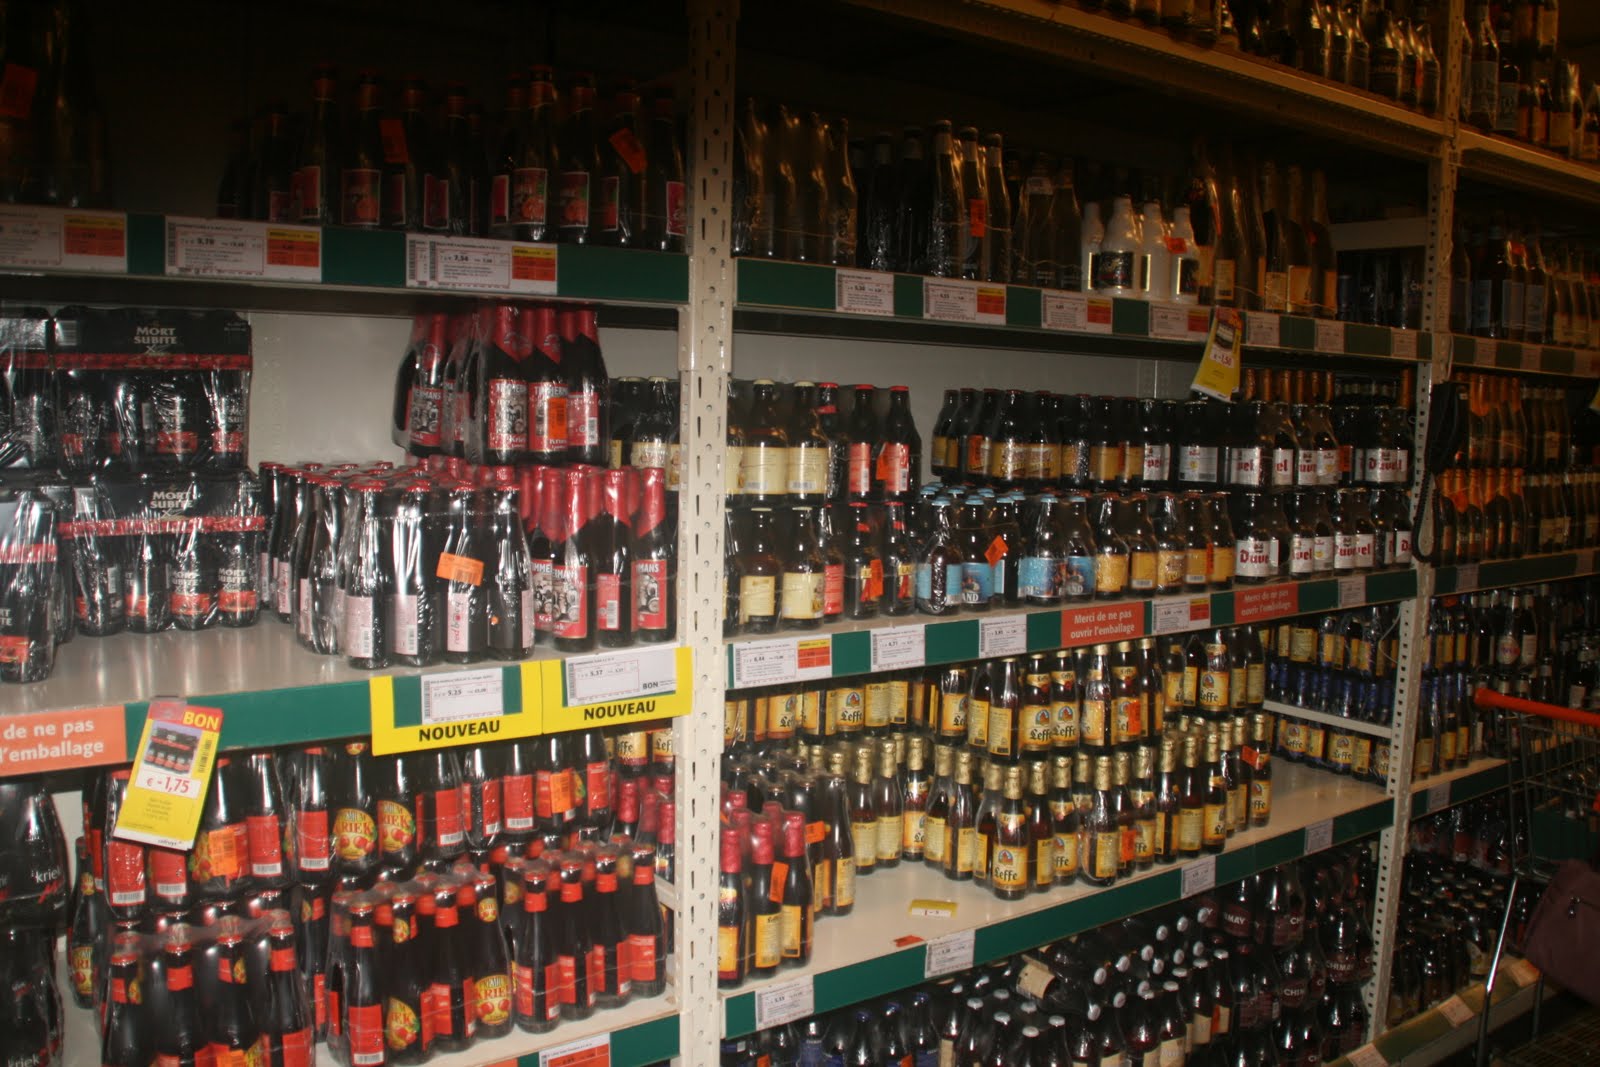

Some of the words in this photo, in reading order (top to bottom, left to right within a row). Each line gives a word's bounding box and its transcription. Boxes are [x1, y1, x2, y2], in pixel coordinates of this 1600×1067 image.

[136, 326, 176, 336] MORT
[134, 336, 178, 345] SUBITE
[152, 491, 191, 500] MORT
[1240, 549, 1270, 564] Duve
[1074, 613, 1095, 624] Merci
[1097, 612, 1107, 621] de
[1108, 612, 1117, 620] ne
[1119, 610, 1132, 621] pas
[1070, 628, 1092, 639] ouvrir
[1094, 624, 1135, 636] l'emballage
[642, 682, 659, 690] BON
[584, 700, 656, 721] NOUVEAU
[182, 711, 220, 730] BON
[3, 724, 27, 739] de
[33, 723, 55, 737] ne
[63, 719, 94, 737] pas
[419, 720, 500, 742] NOUVEAU
[994, 867, 1018, 881] Leffe
